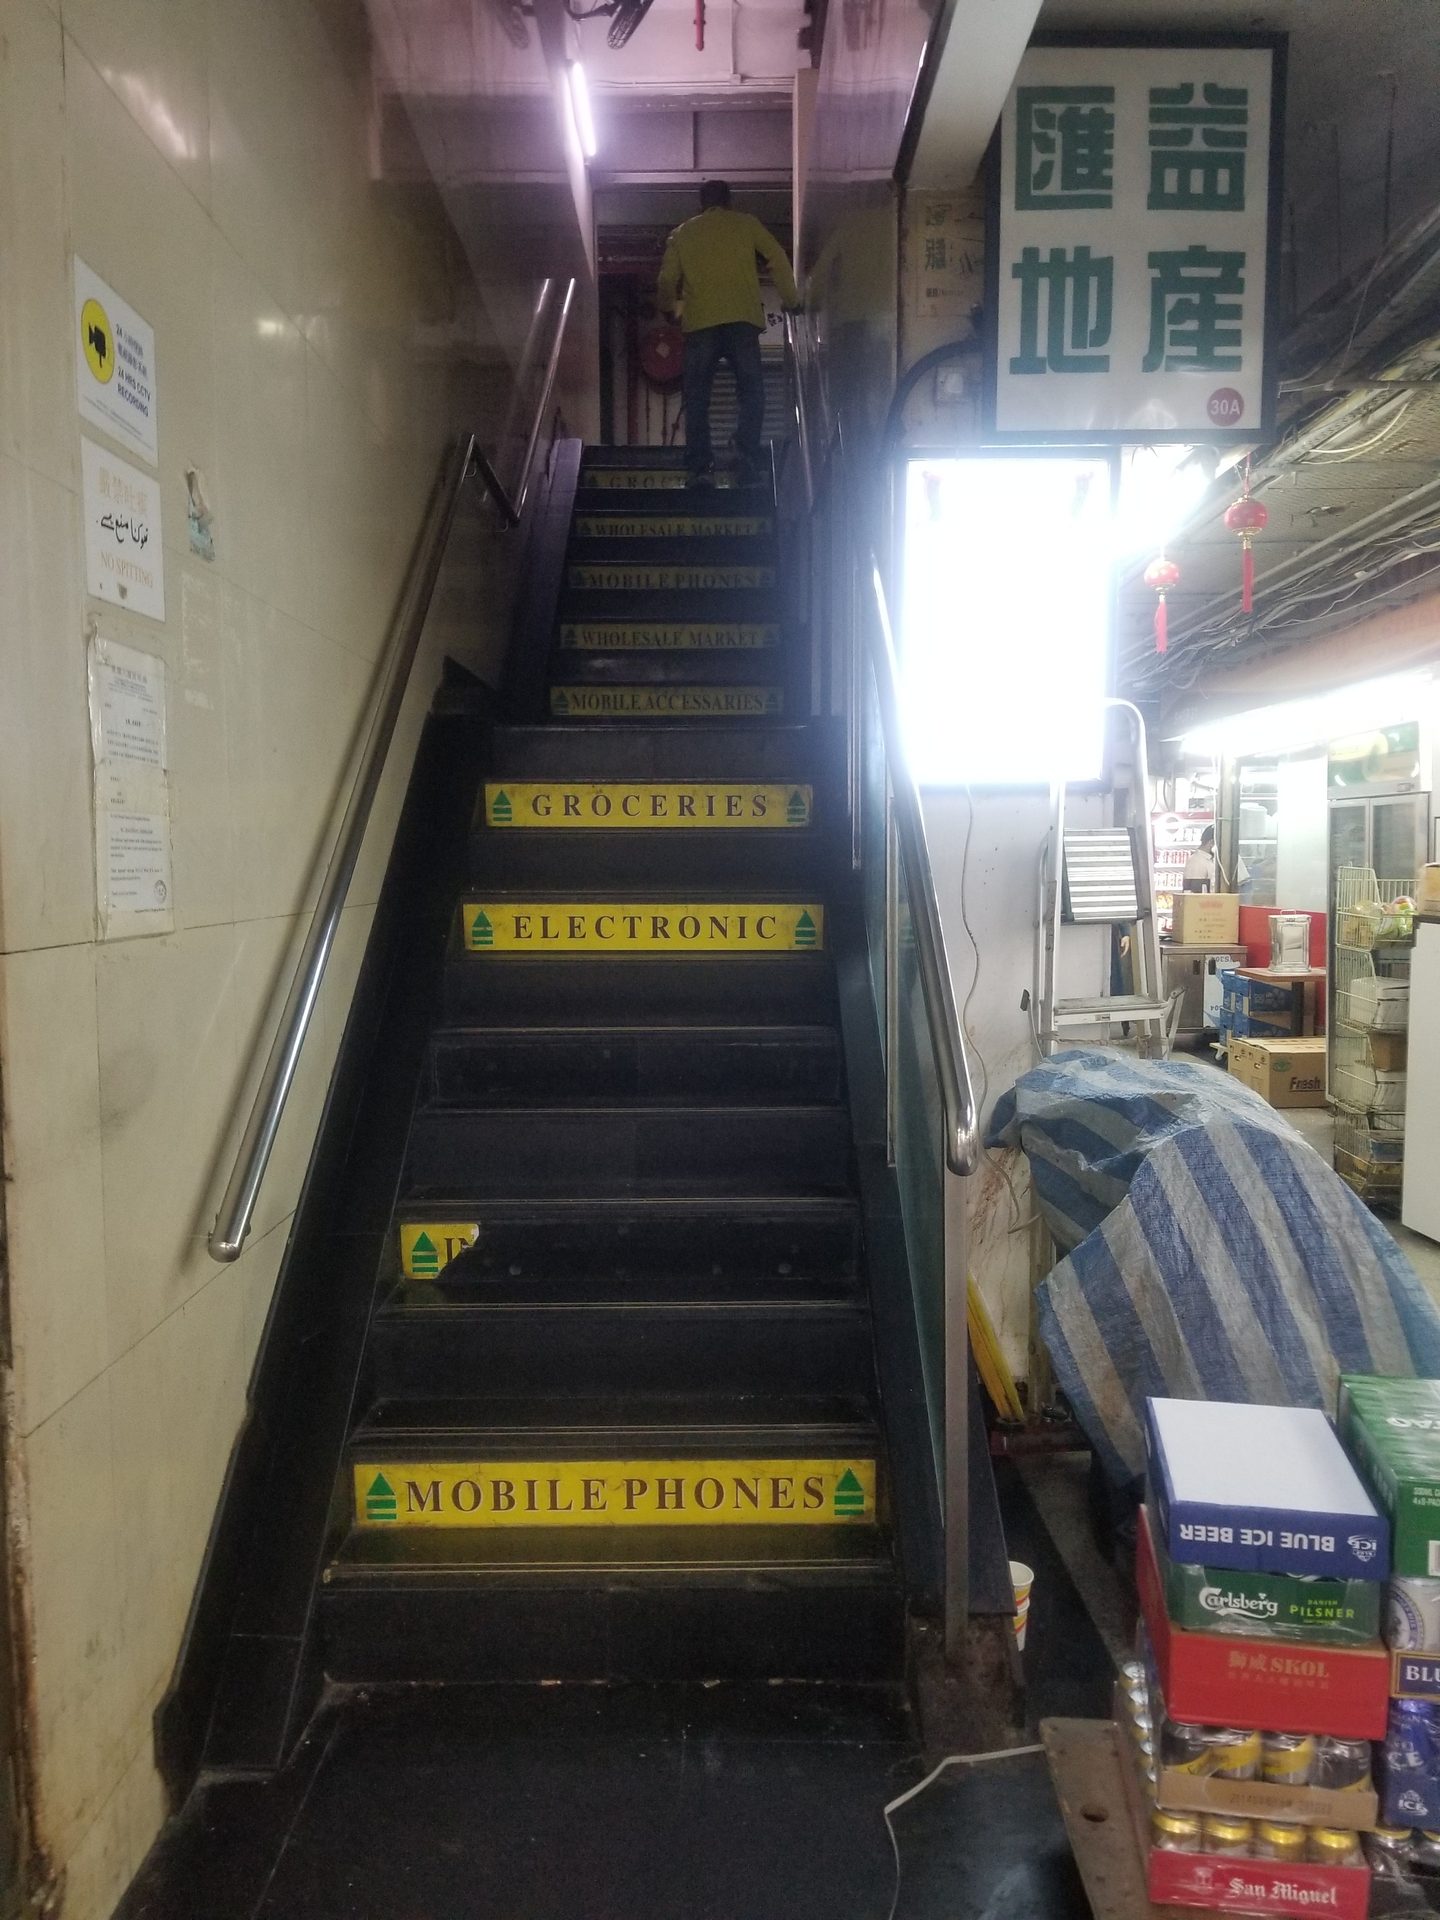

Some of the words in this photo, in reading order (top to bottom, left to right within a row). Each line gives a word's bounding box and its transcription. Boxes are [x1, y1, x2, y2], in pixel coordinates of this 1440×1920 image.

[117, 382, 149, 417] RECORDING
[136, 381, 151, 402] CCTV
[1210, 399, 1241, 416] 30A
[594, 523, 684, 536] WHOLESALE
[690, 523, 753, 536] MARKET
[100, 551, 114, 570] NO
[115, 557, 153, 589] SPITTING
[588, 573, 671, 588] MOBILE
[675, 572, 760, 588] PHONES
[581, 631, 683, 647] WHOLESALE
[689, 631, 759, 647] MARKET
[571, 694, 641, 710] MOBILE
[646, 693, 764, 710] ACCESSARIES
[531, 794, 767, 818] GROCERIES
[512, 914, 777, 940] ELECTRONIC
[1289, 1076, 1321, 1090] Fresh
[405, 1479, 607, 1513] MOBILE
[622, 1476, 825, 1511] PHONES
[1179, 1523, 1234, 1543] BEER
[1240, 1528, 1273, 1546] ICE
[1280, 1532, 1335, 1552] BLUE
[1199, 1586, 1279, 1618] Carlsberg
[1289, 1603, 1355, 1619] PILSNER
[1270, 1657, 1330, 1678] SKOL
[1229, 1877, 1266, 1898] San
[1269, 1880, 1338, 1907] Miguel
